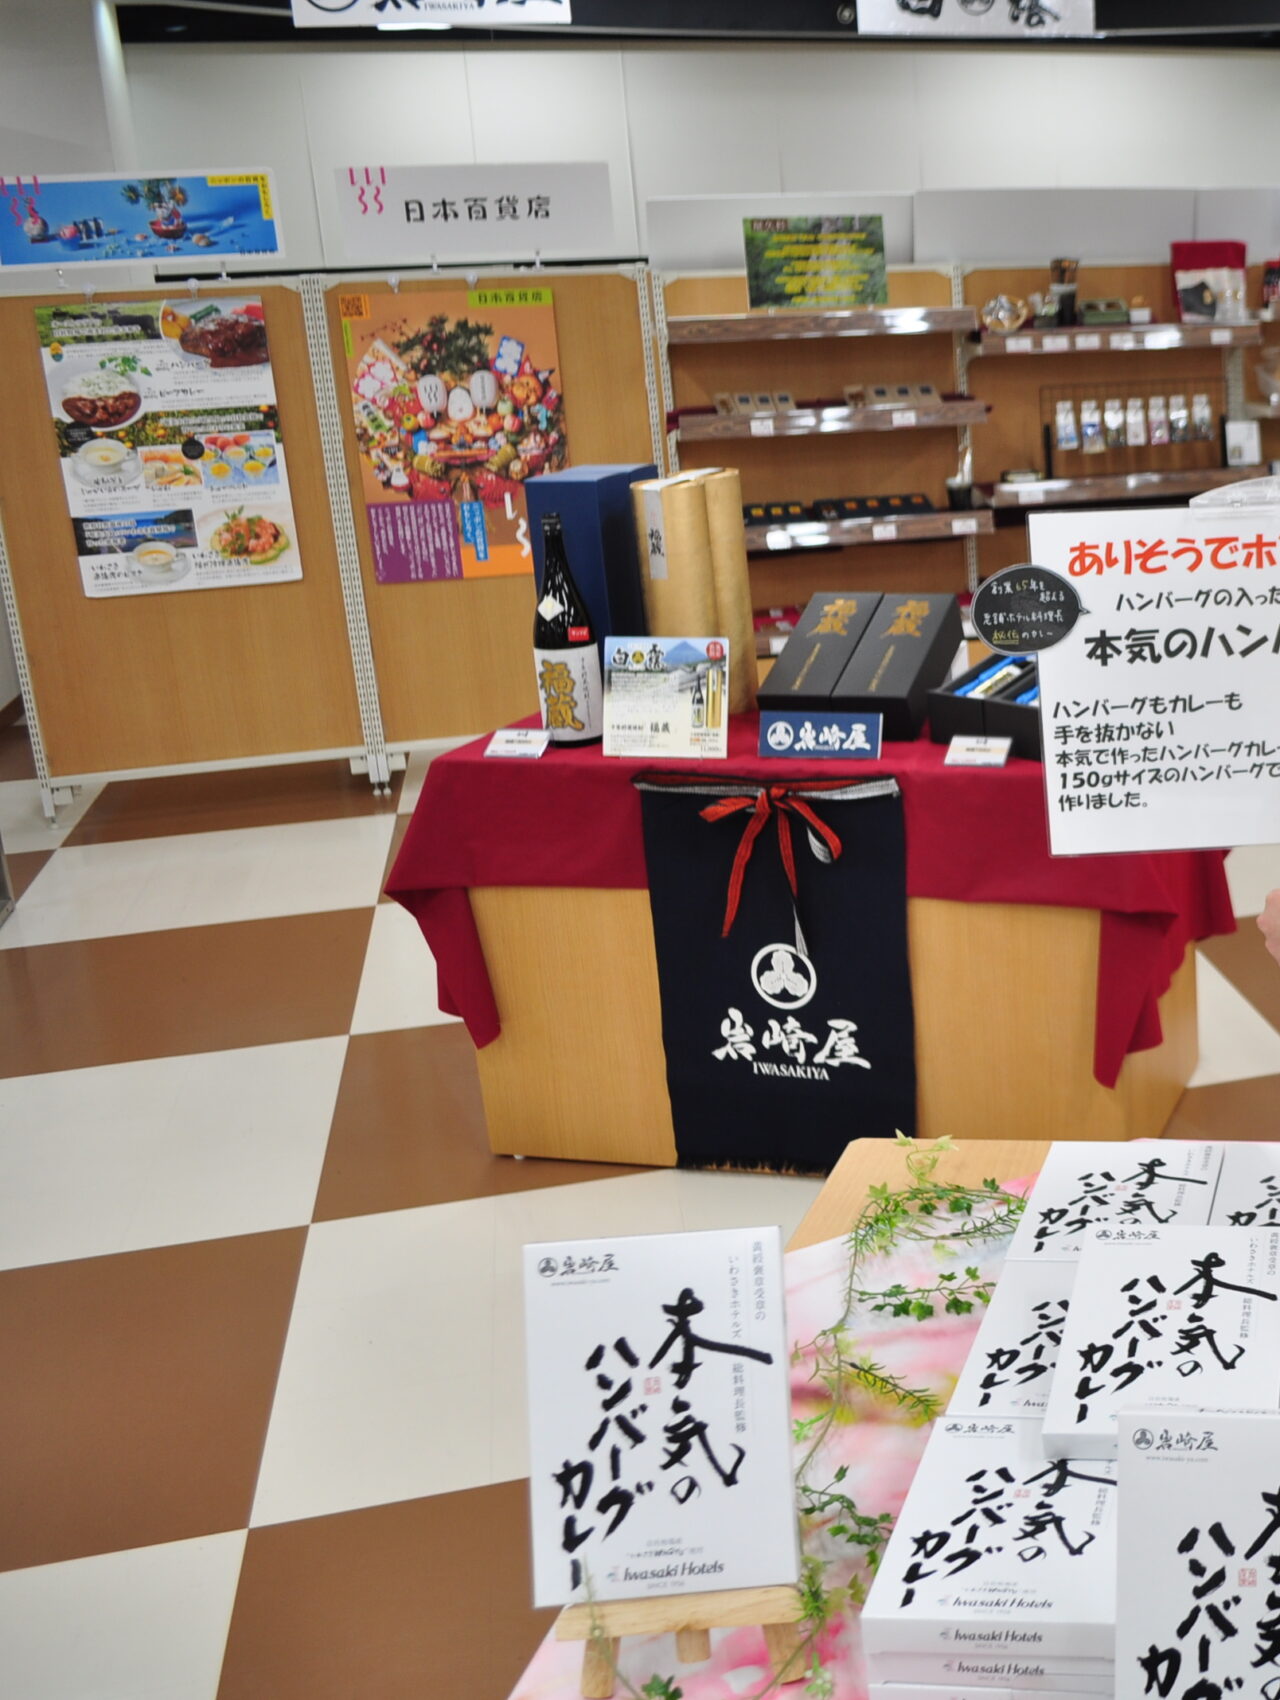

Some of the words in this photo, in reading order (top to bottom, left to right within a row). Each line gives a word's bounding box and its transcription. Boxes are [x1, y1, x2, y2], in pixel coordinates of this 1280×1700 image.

[404, 195, 550, 223] 日本百貨店
[478, 291, 543, 305] 日本百貨店
[1053, 692, 1244, 719] ハンバーグもカレーも
[1054, 722, 1175, 746] 手を抜かない
[1058, 791, 1149, 813] 作りました。
[711, 1007, 871, 1069] 岩崎屋
[752, 1061, 830, 1081] IWASAKIYA
[1064, 1171, 1116, 1236] ハンバーグ
[1121, 1158, 1208, 1225] 本気の
[1034, 1207, 1070, 1253] カレー
[728, 1255, 743, 1339] いわさきホテルズ
[1170, 1251, 1278, 1378] 本気の
[1110, 1274, 1169, 1395] ハンバーグ
[649, 1287, 774, 1505] 本気の
[731, 1362, 748, 1434] 総料理長監修
[978, 1347, 1021, 1408] カレー
[1075, 1342, 1115, 1425] カレー
[585, 1336, 656, 1543] ハンバーグ
[1156, 1429, 1218, 1451] 岩崎屋
[552, 1458, 597, 1592] カレー
[941, 1466, 1016, 1580] ハンバーグ
[624, 1564, 679, 1582] Iwasaki
[680, 1559, 725, 1577] Hotels
[900, 1529, 951, 1608] カレー
[953, 1597, 1008, 1608] Iwasaki
[1010, 1598, 1053, 1609] Hotels
[954, 1629, 1002, 1641] Iwasaki
[1004, 1630, 1043, 1642] Hotels
[957, 1661, 1005, 1674] Iwasaki
[1006, 1663, 1045, 1676] Hotels
